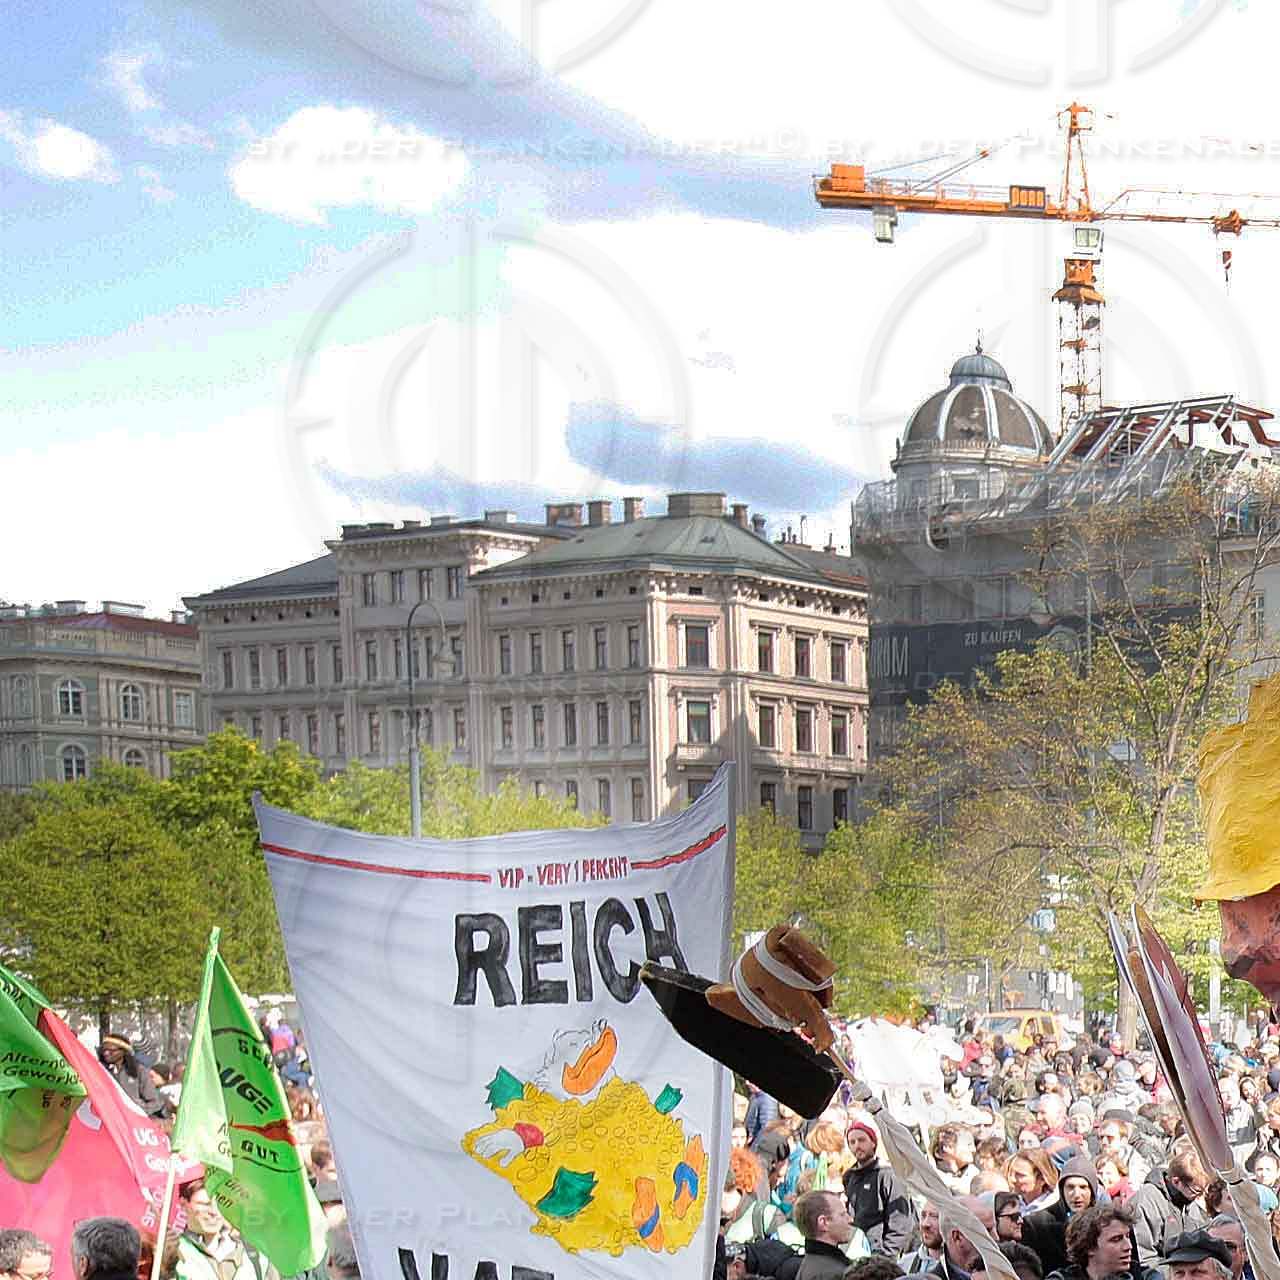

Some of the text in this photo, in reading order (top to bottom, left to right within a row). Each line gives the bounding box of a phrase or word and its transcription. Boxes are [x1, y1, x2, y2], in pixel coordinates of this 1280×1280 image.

[981, 628, 1023, 645] KAUFEN
[498, 869, 524, 889] VIP
[537, 864, 571, 887] VERY
[583, 856, 629, 882] PERCENT
[453, 892, 690, 1008] REICH
[218, 1062, 274, 1115] UGE
[241, 1139, 281, 1164] GUT
